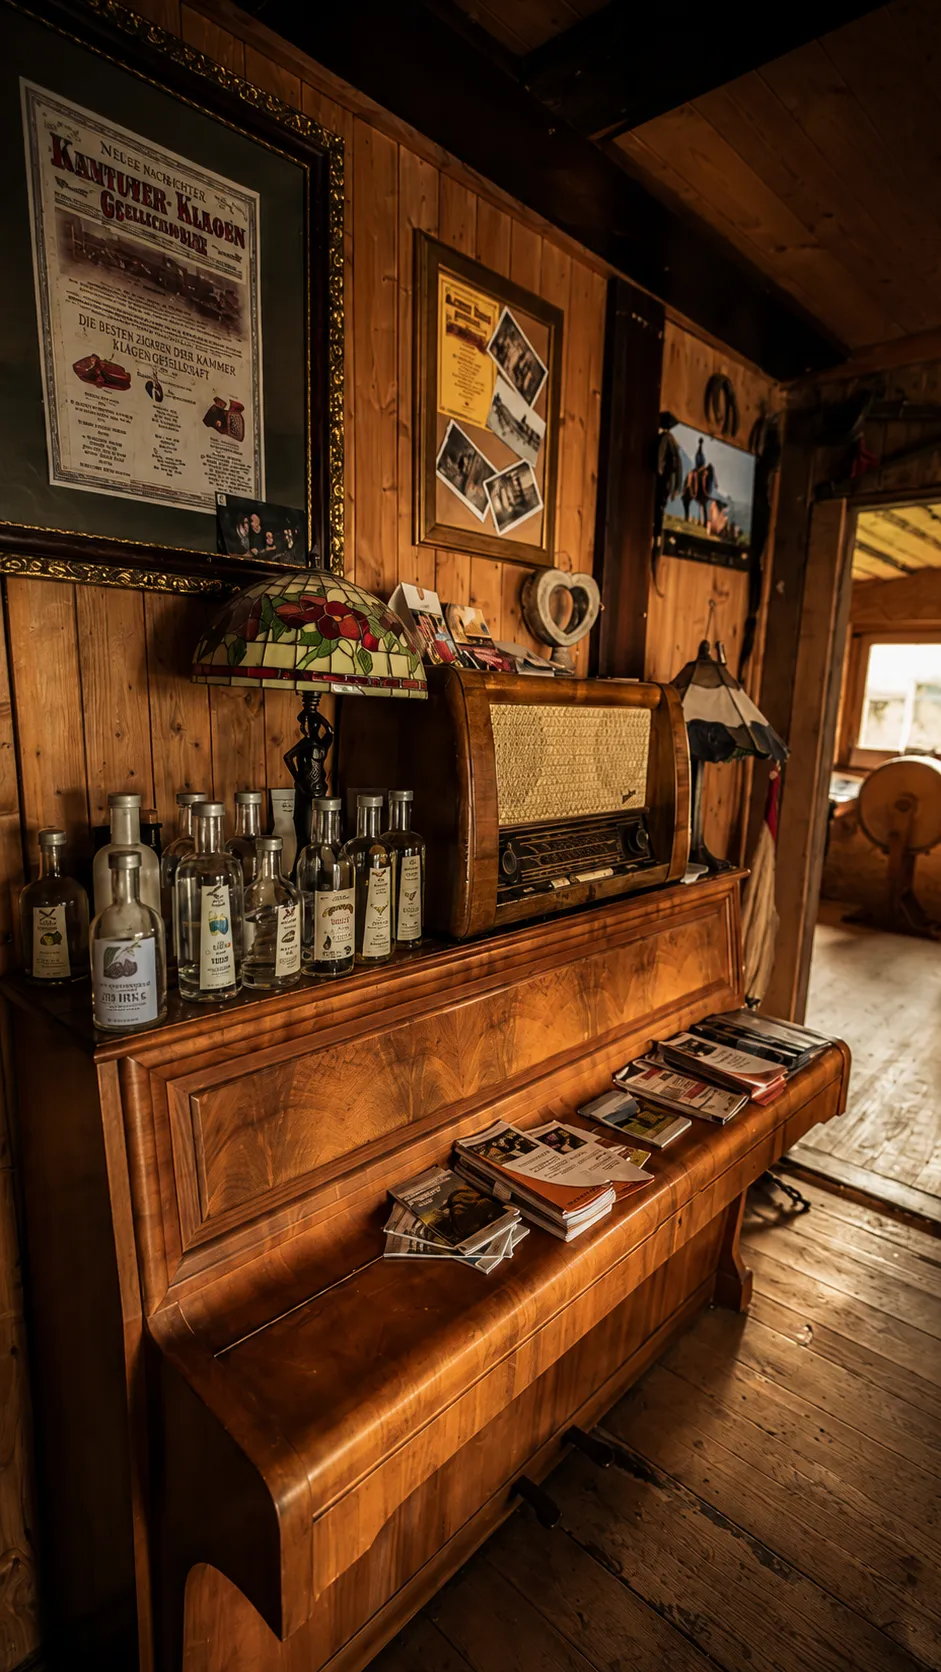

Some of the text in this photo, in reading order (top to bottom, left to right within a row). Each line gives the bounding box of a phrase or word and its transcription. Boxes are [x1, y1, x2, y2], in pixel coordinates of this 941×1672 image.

[79, 313, 97, 329] DIE
[99, 320, 134, 344] BESTEN
[196, 354, 236, 376] KAMMER
